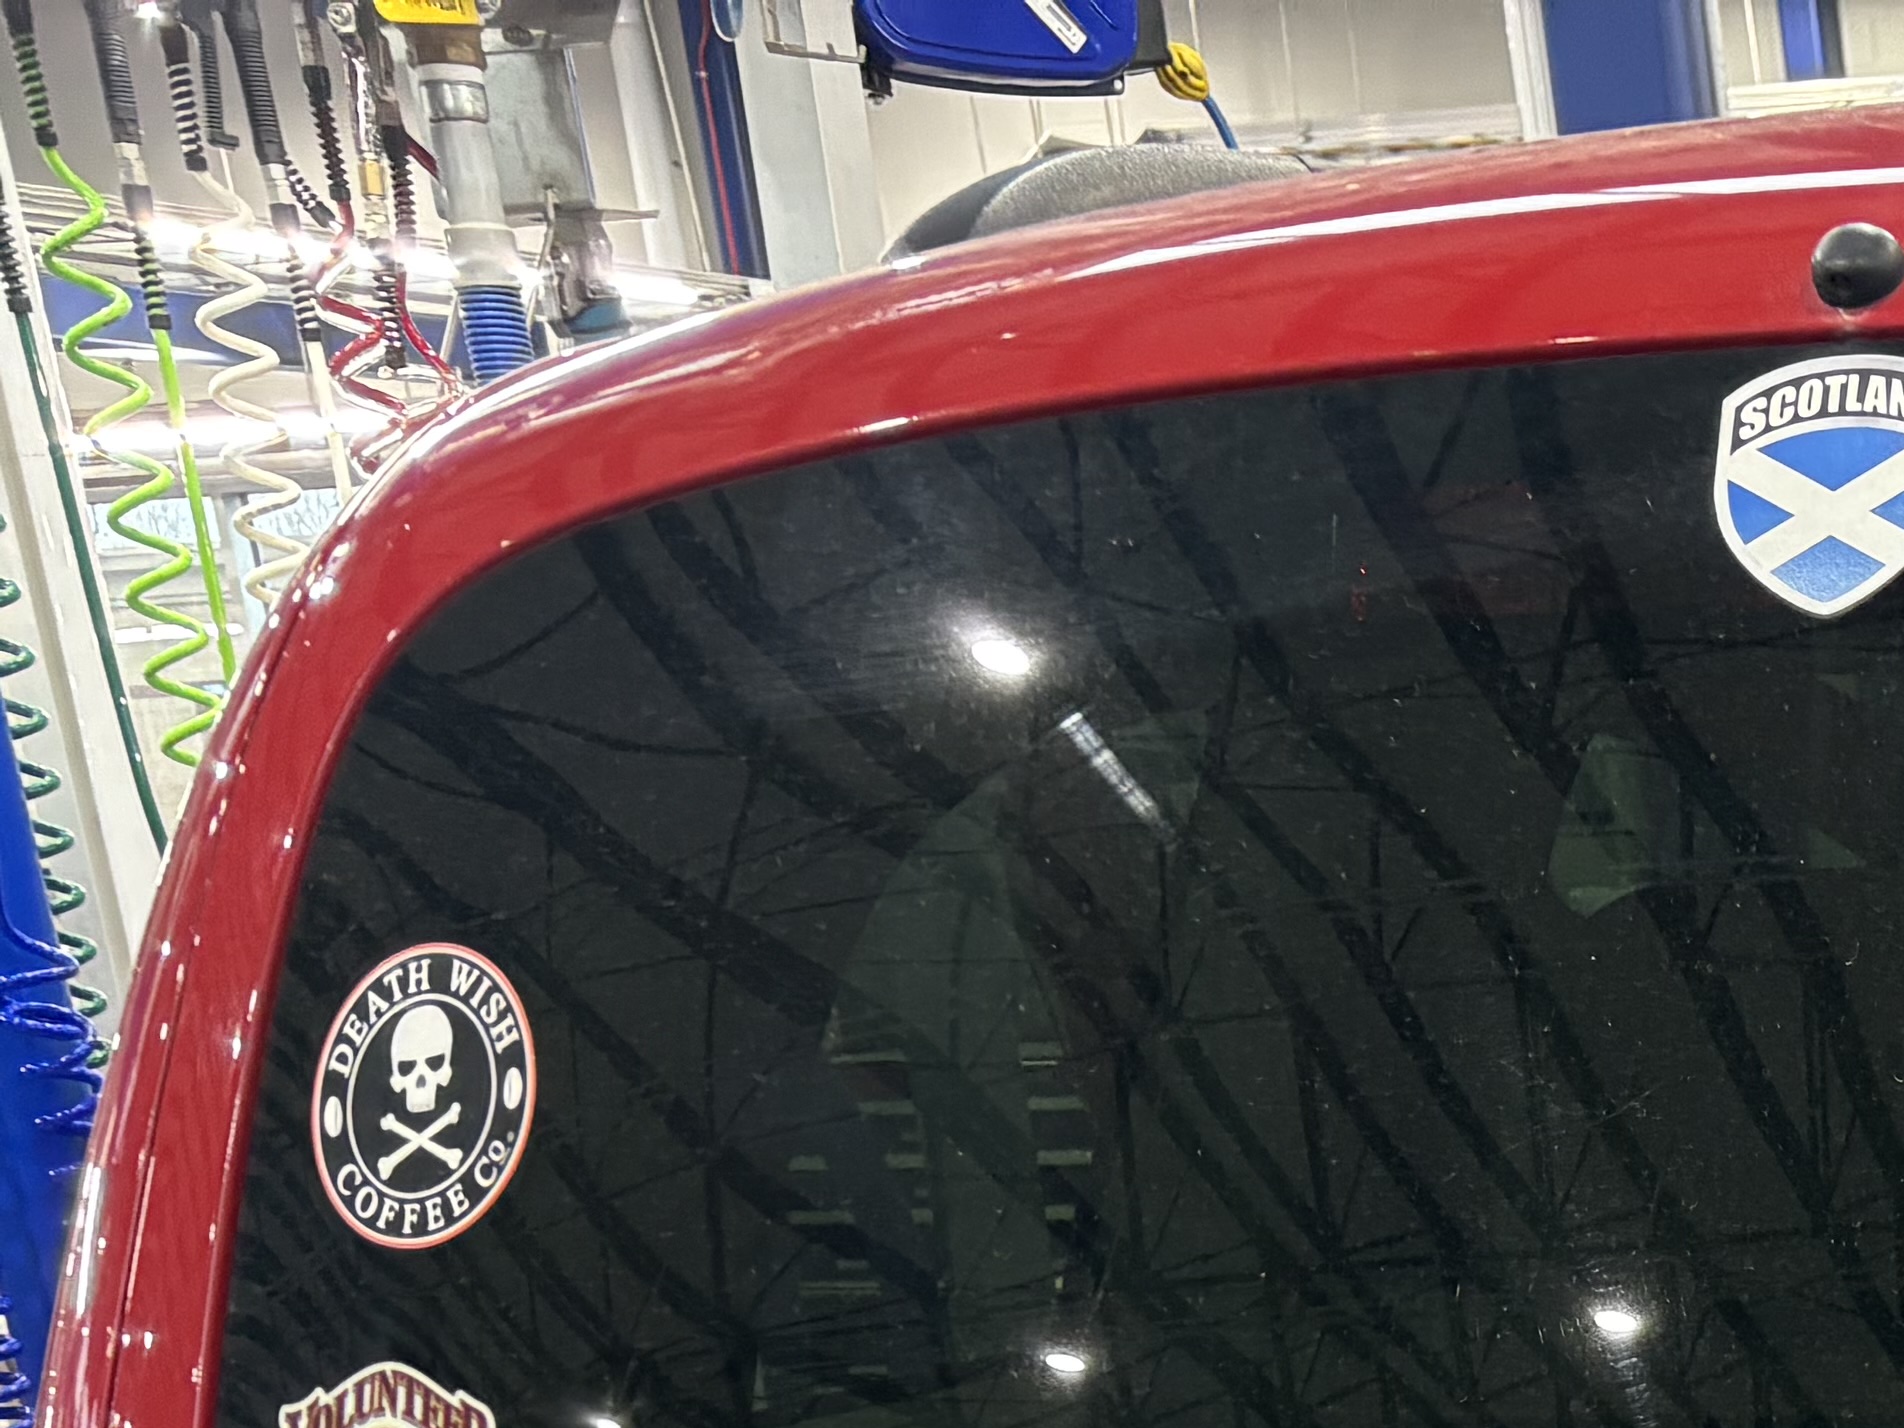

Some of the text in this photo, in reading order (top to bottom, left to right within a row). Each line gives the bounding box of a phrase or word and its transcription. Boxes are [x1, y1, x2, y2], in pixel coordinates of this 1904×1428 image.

[329, 958, 521, 1078] DEATH WISH
[336, 1163, 471, 1235] COFFEE
